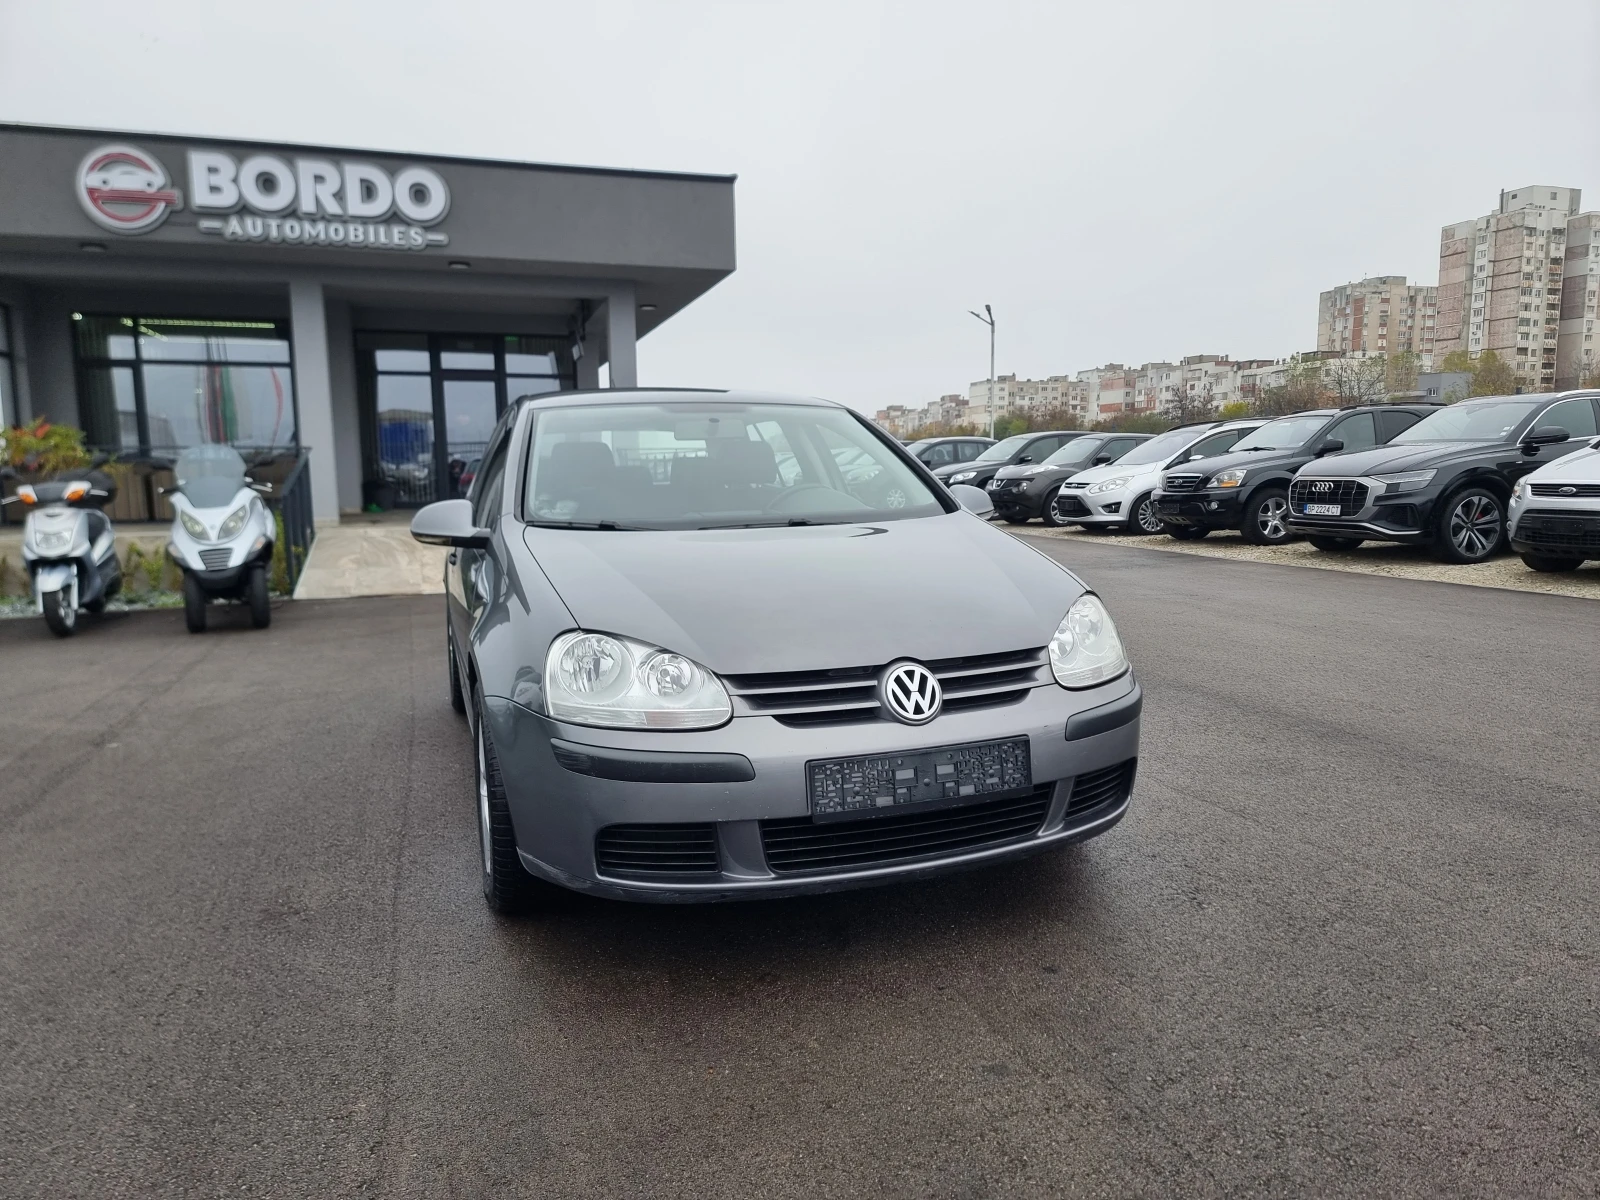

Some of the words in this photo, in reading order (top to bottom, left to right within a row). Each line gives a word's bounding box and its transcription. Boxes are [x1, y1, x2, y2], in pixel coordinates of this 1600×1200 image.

[190, 151, 447, 222] BORDO
[226, 216, 425, 246] AUTOMOBILES
[1315, 505, 1330, 514] 2224
[1330, 505, 1340, 515] CT
